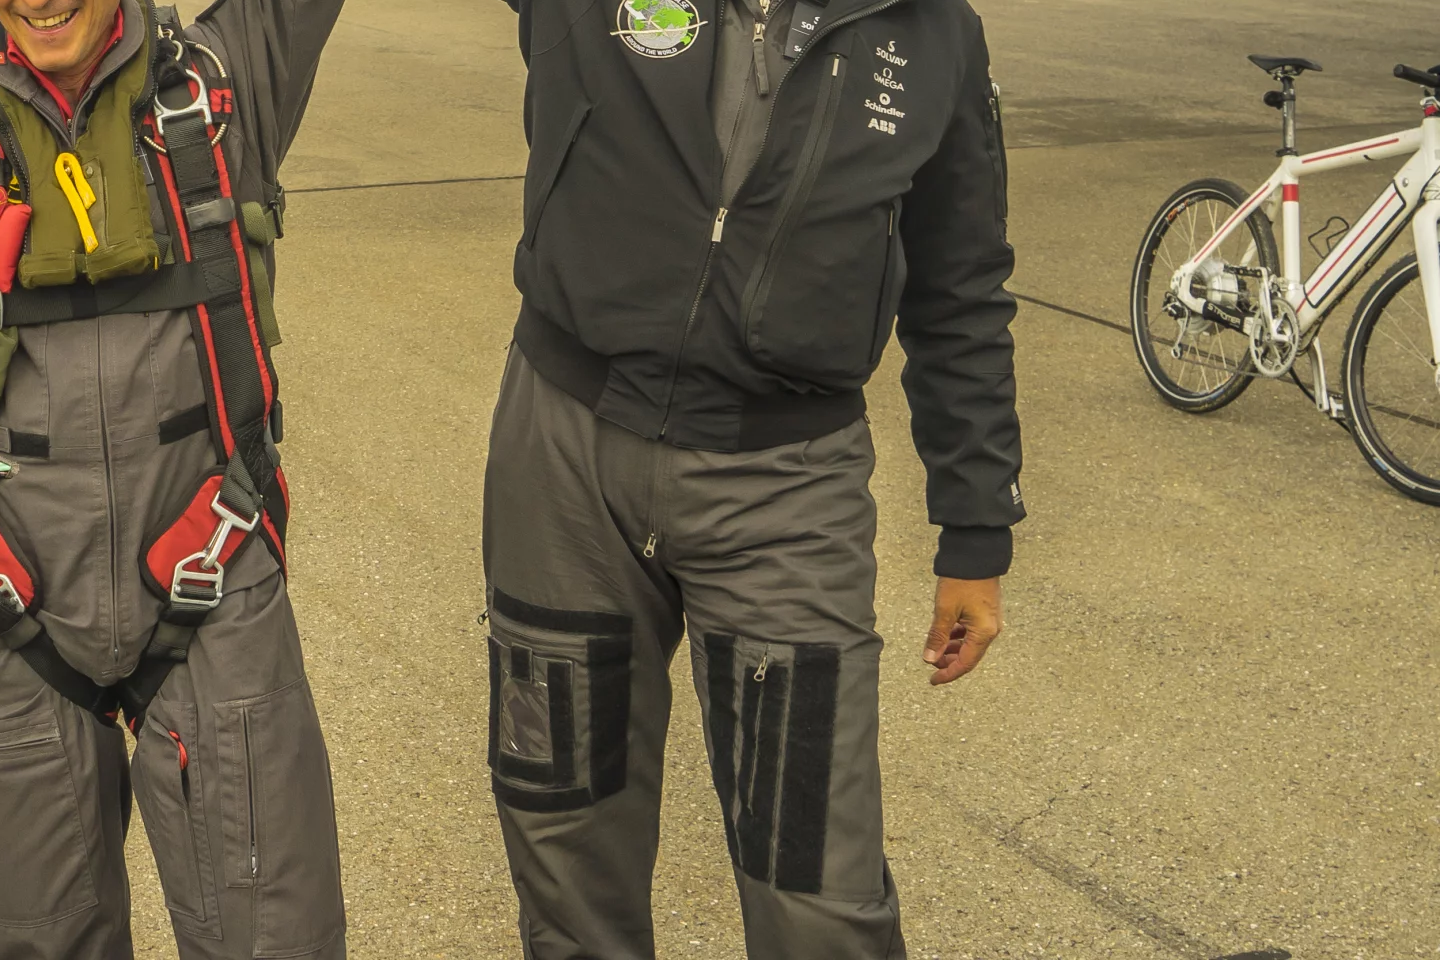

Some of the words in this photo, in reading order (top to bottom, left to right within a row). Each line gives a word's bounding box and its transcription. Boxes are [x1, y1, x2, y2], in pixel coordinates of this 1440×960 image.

[625, 35, 645, 52] AROUND
[657, 47, 678, 56] WORLD
[875, 46, 908, 67] SOLVAY
[873, 72, 905, 92] OMEGA
[863, 99, 906, 119] Schindler
[868, 117, 897, 136] ABB
